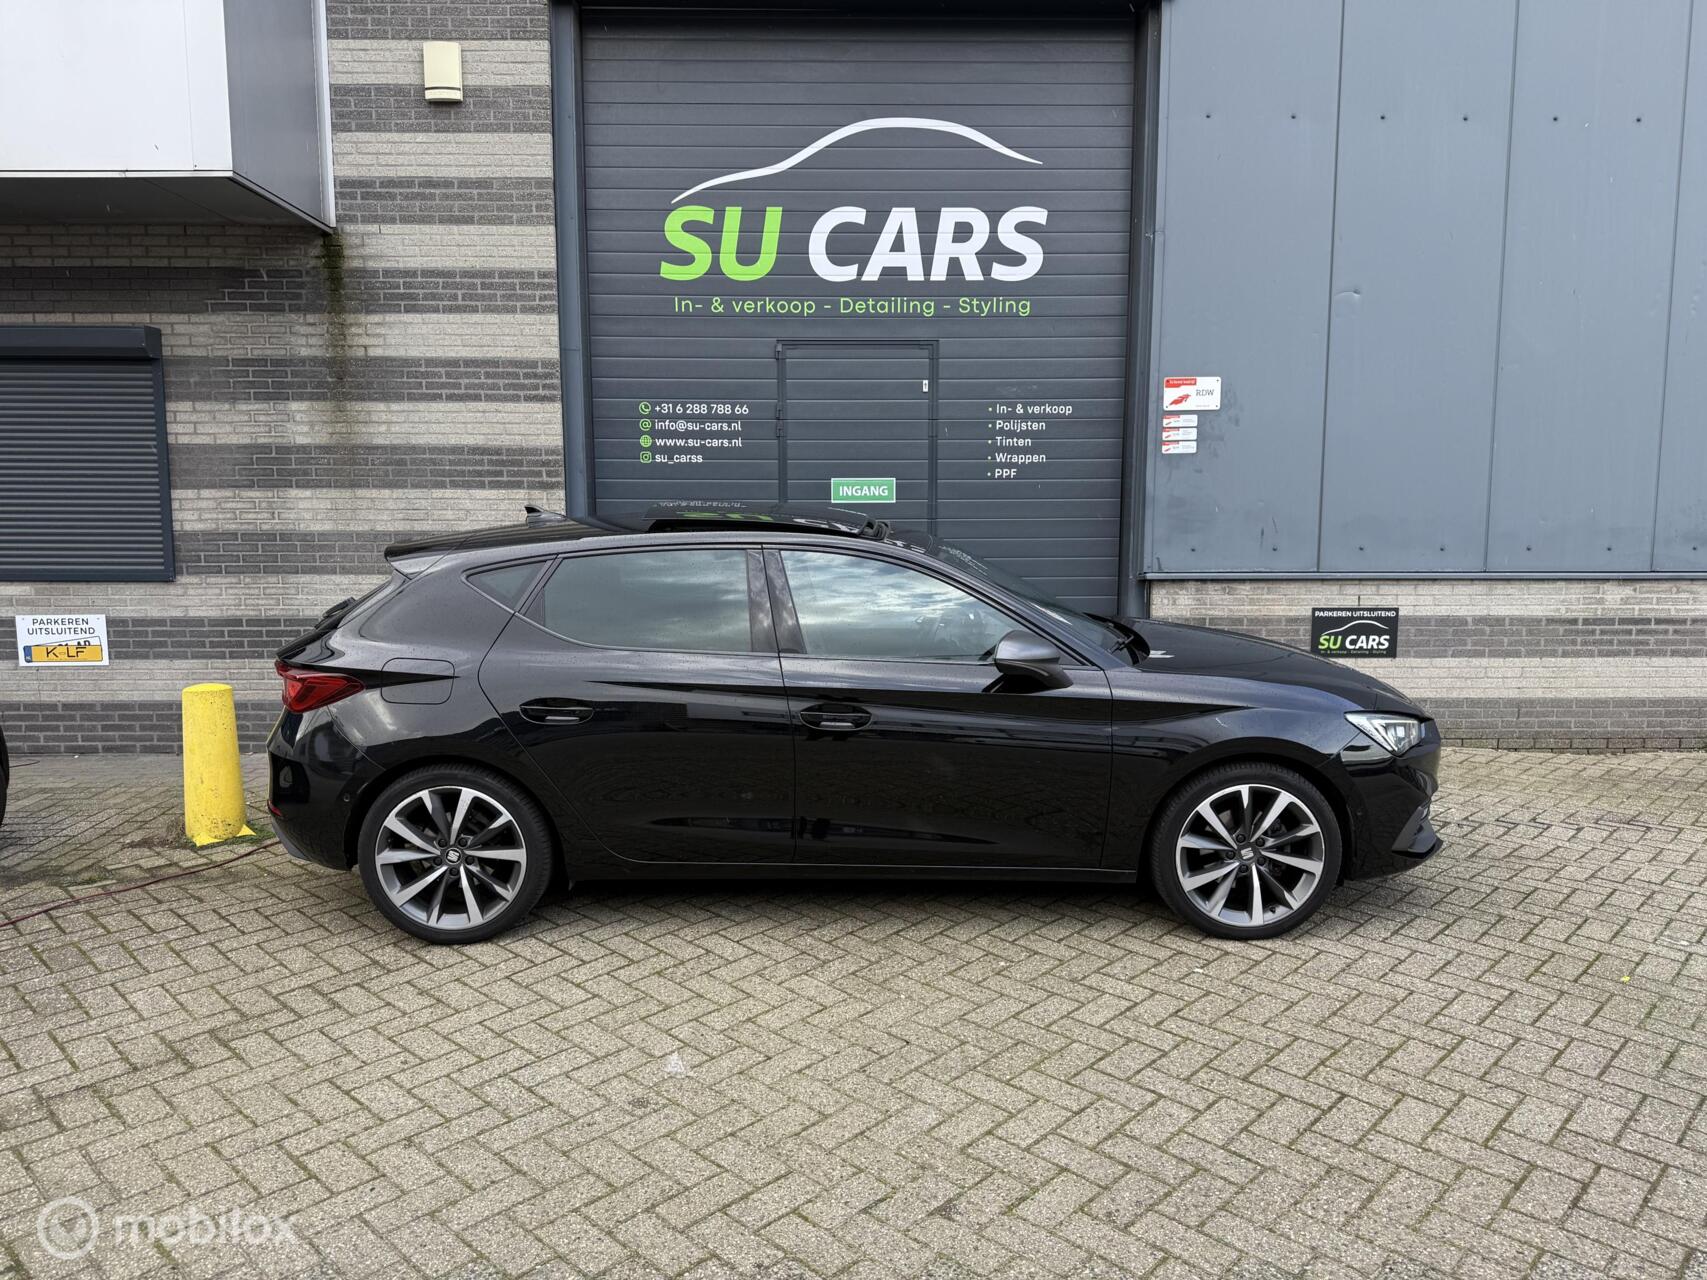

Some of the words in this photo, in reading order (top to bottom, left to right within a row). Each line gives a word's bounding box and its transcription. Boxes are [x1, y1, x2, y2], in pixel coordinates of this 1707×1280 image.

[660, 205, 783, 281] SU
[808, 206, 1049, 282] CARS
[674, 297, 703, 313] In-
[711, 297, 724, 313] &
[732, 297, 816, 317] verkoop
[840, 297, 935, 317] Detailing
[959, 297, 1031, 317] Styling
[1196, 389, 1214, 397] RDW
[655, 403, 673, 414] +31
[676, 403, 683, 414] 6
[686, 403, 708, 414] 288
[710, 404, 732, 415] 788
[735, 404, 749, 415] 66
[996, 403, 1013, 414] In-
[1015, 403, 1024, 414] &
[1027, 403, 1073, 416] verkoop
[655, 420, 742, 432] info@su-cars.nl
[996, 419, 1046, 432] Polijsten
[655, 437, 743, 447] www.su-cars.nl
[995, 436, 1032, 447] Tinten
[655, 454, 703, 464] su_carss
[995, 452, 1046, 464] Wrappen
[995, 468, 1017, 479] PPF
[839, 485, 889, 497] INGANG
[32, 617, 89, 626] PARKEREN
[27, 627, 96, 635] UITSLUITEND
[1318, 635, 1342, 649] SU
[1345, 635, 1390, 650] CARS
